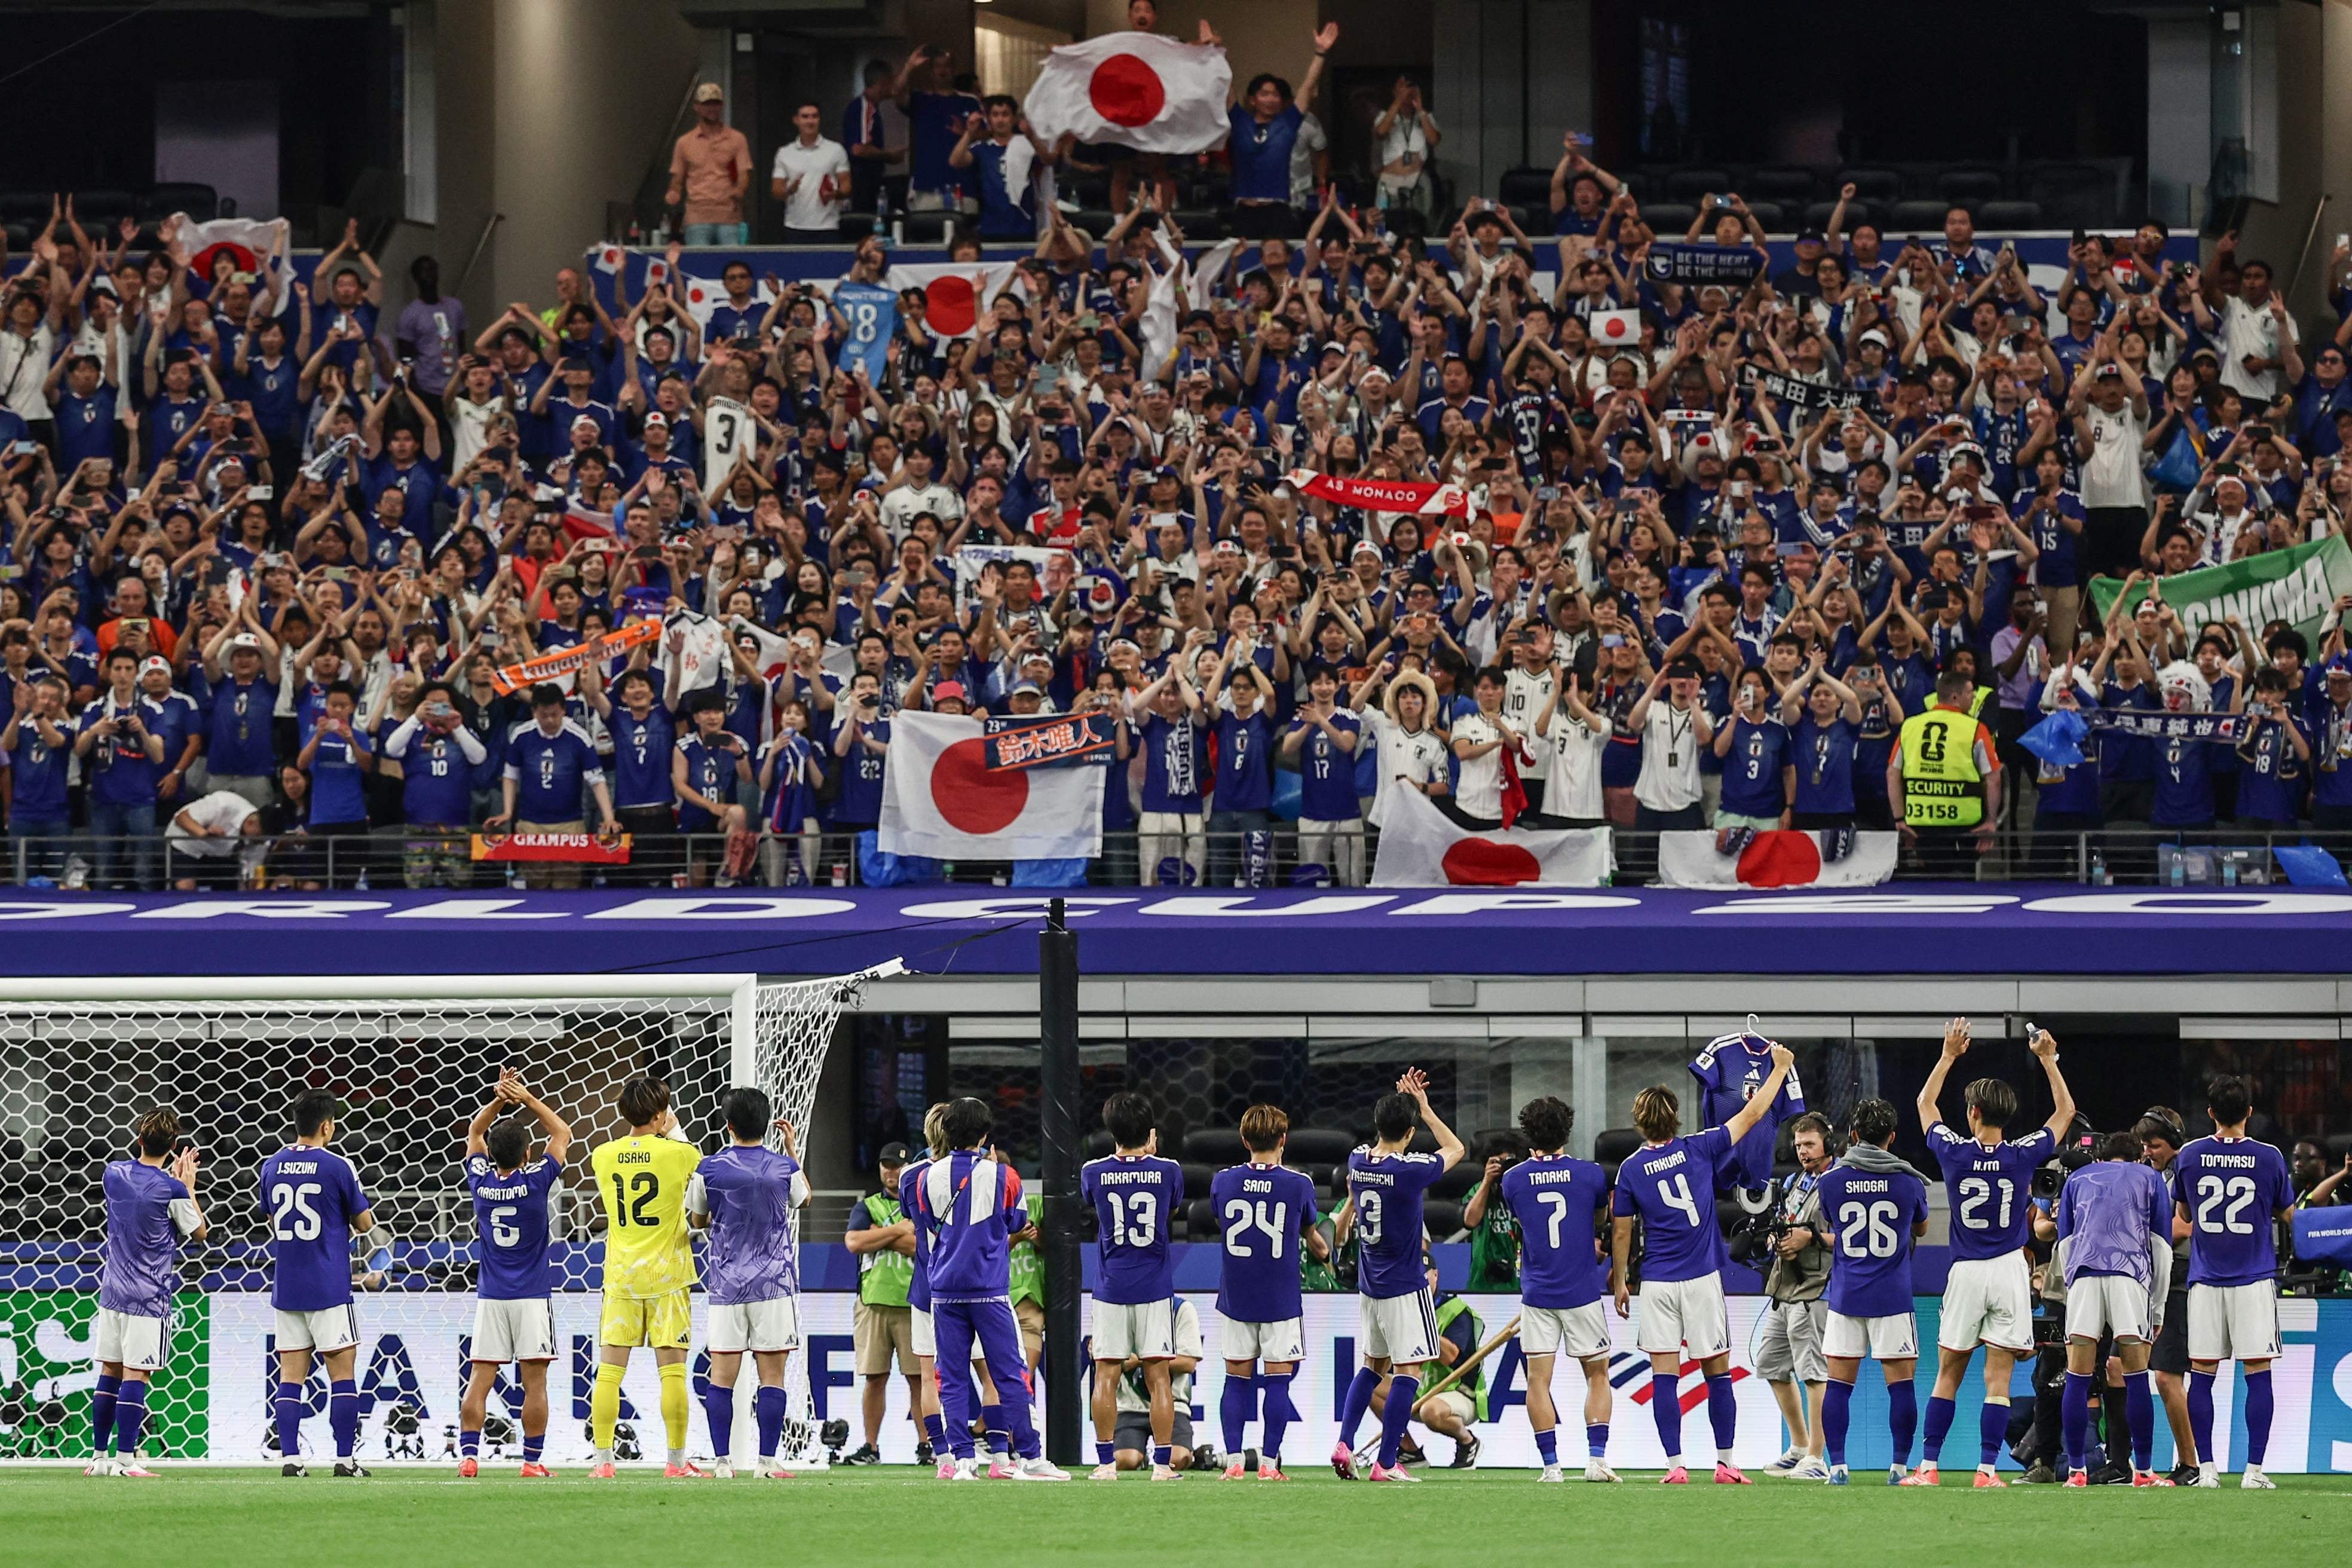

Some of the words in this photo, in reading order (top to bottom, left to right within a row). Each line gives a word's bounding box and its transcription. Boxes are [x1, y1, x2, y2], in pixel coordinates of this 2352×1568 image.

[843, 303, 877, 343] 18
[715, 414, 735, 454] 3
[1325, 477, 1344, 491] AS
[1352, 485, 1417, 503] MONACO
[2041, 531, 2056, 550] 15
[1511, 694, 1524, 710] 10
[987, 719, 1000, 733] 23
[636, 748, 646, 764] 7
[1558, 739, 1567, 755] 3
[431, 760, 447, 776] 10
[1314, 759, 1329, 779] 17
[1747, 760, 1759, 779] 3
[2256, 755, 2271, 774] 18
[1907, 780, 1965, 795] ECURITY
[513, 833, 589, 848] GRAMPUS
[618, 1152, 650, 1163] OSAKO
[1644, 1150, 1686, 1175] ITAKURA
[1974, 1160, 1999, 1172] H.ITO
[2201, 1154, 2255, 1168] TOMIYASU
[277, 1161, 318, 1175] J.SUZUKI
[1352, 1168, 1395, 1187] TANIGUCHI
[1528, 1169, 1571, 1186] TANAKA
[1101, 1170, 1162, 1186] NAKAMURA
[1243, 1179, 1272, 1193] SANO
[1845, 1180, 1888, 1193] SHIOGAI
[477, 1184, 528, 1200] NAGATOMO
[612, 1172, 660, 1228] 12
[1658, 1172, 1700, 1227] 4
[272, 1183, 322, 1242] 25
[1959, 1178, 2014, 1229] 21
[2197, 1175, 2256, 1234] 22
[490, 1206, 520, 1248] 5
[1107, 1192, 1156, 1247] 13
[1359, 1190, 1382, 1245] 3
[1537, 1192, 1567, 1249] 7
[1225, 1199, 1286, 1259] 24
[1839, 1201, 1898, 1257] 26
